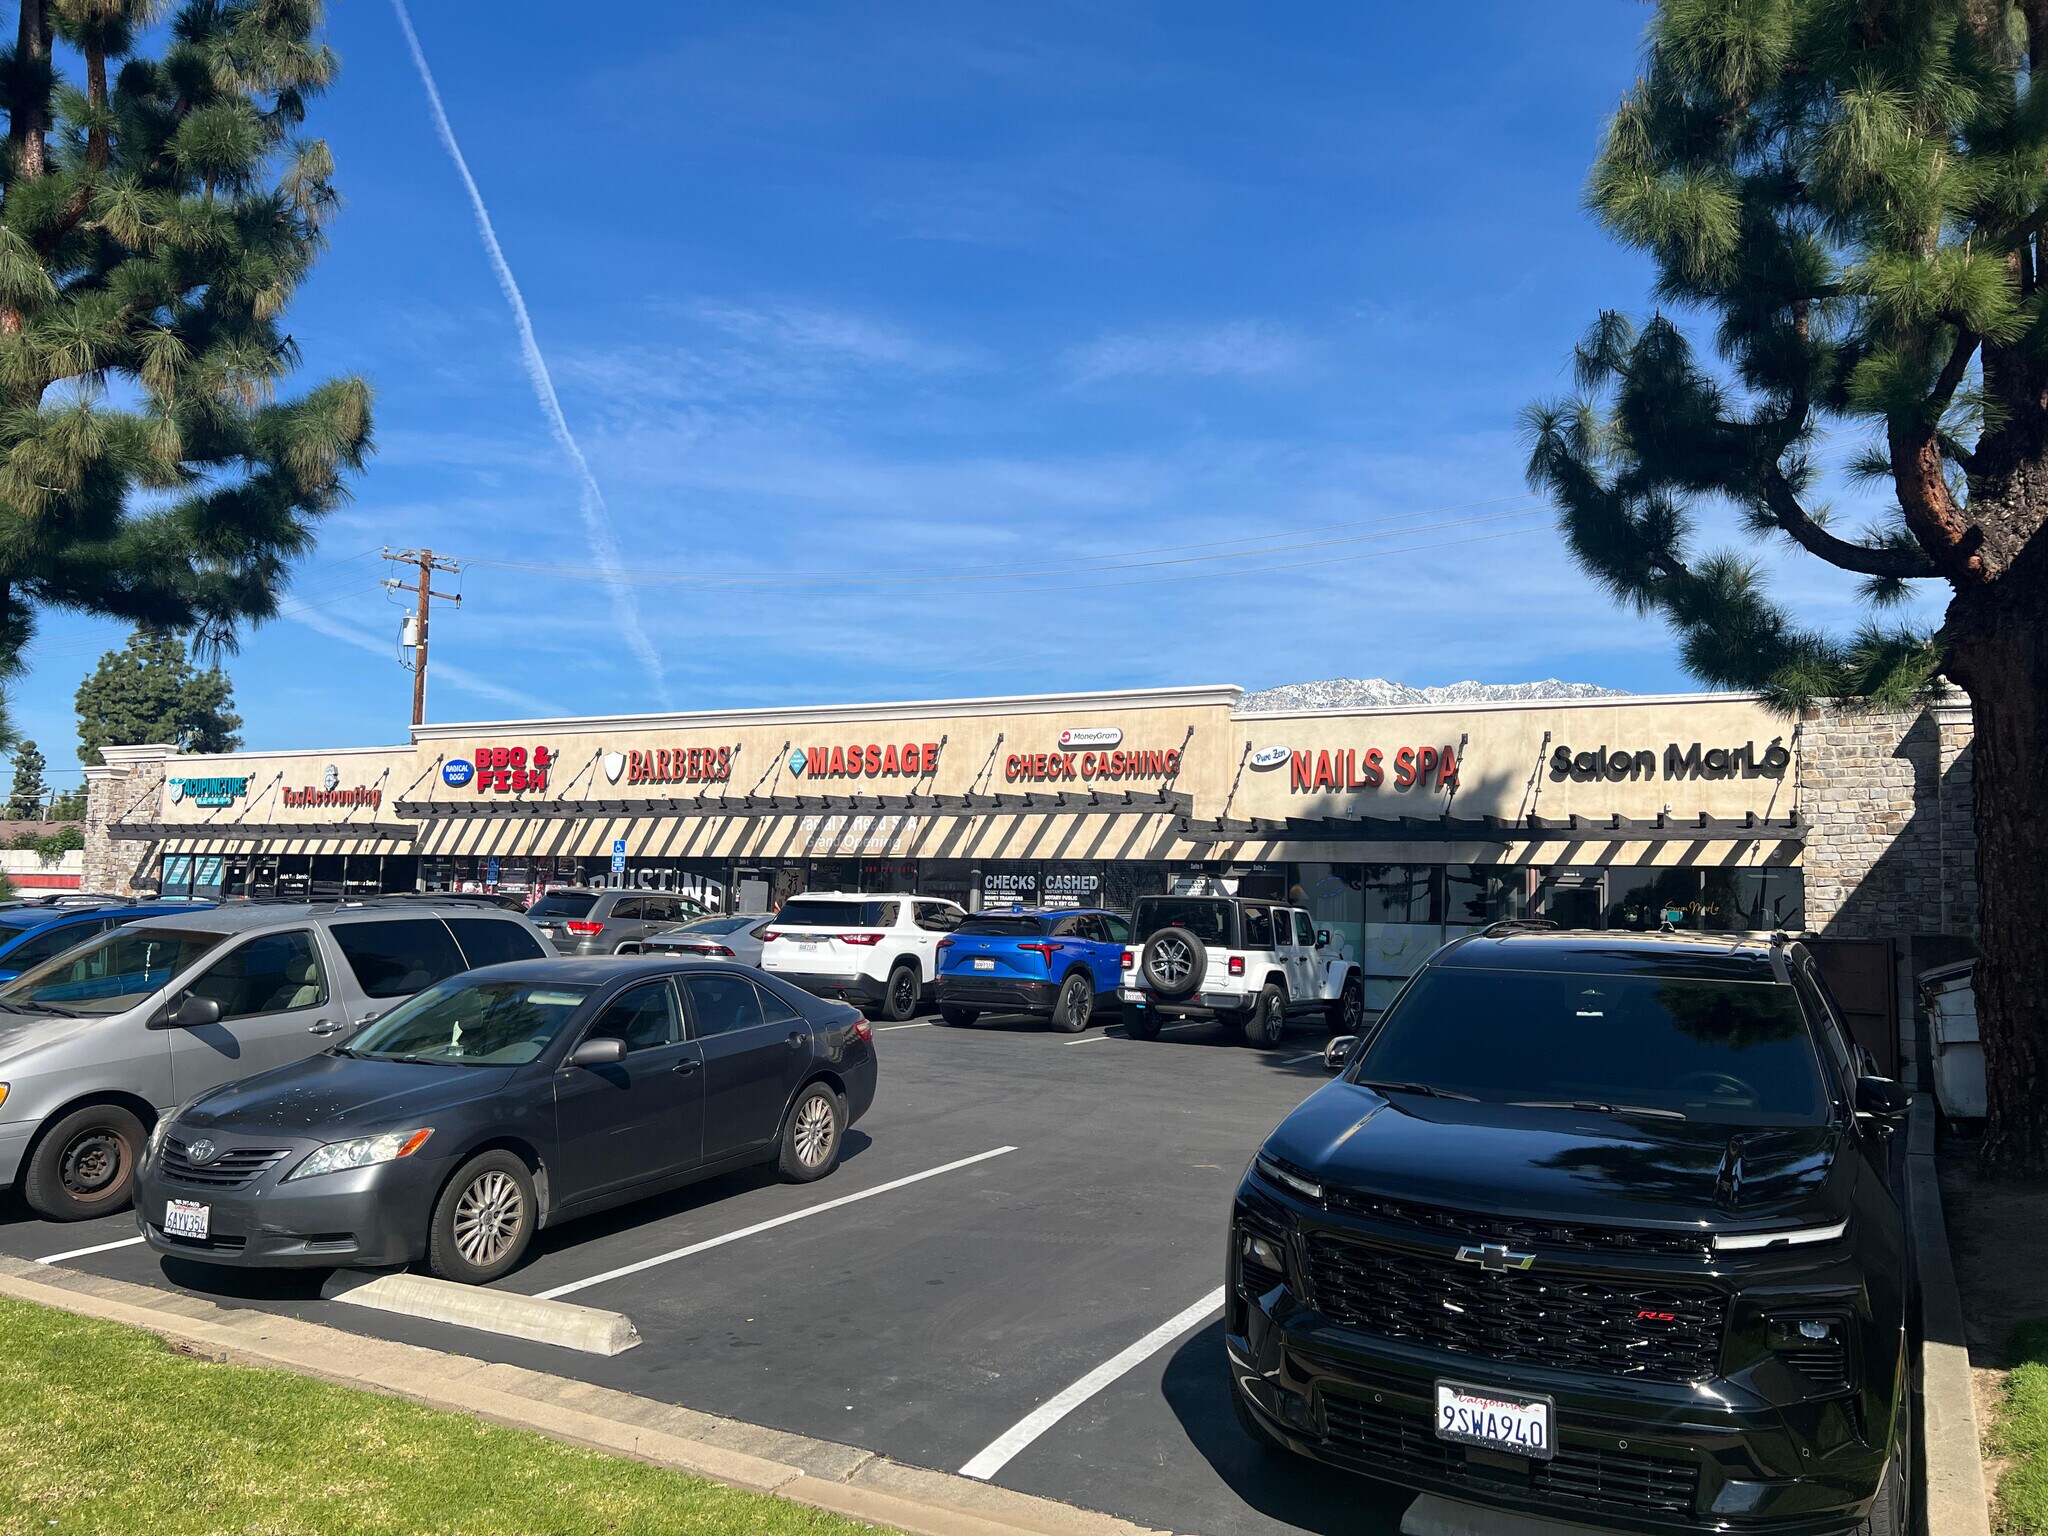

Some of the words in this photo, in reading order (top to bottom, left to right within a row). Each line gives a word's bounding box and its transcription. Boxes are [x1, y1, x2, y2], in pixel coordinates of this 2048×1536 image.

[1073, 732, 1118, 745] MoneyGram
[475, 747, 528, 771] BBQ
[534, 746, 552, 769] &
[628, 747, 730, 783] BARBERS
[808, 743, 937, 776] MASSAGE
[1006, 753, 1077, 778] CHECK
[1082, 750, 1180, 776] CASHING
[1255, 753, 1273, 764] Pure
[1273, 749, 1287, 760] Zen
[1292, 749, 1384, 789] NAILS
[1396, 745, 1460, 788] SPA
[1552, 745, 1656, 775] Salon
[184, 777, 247, 796] ACUPUNCTURE
[478, 770, 548, 793] FISH
[282, 785, 380, 809] Tax/Accounting
[800, 815, 836, 831] Facial
[854, 815, 886, 831] Head
[891, 815, 917, 831] SPA
[807, 836, 841, 848] Grand
[844, 834, 903, 850] Opening
[985, 875, 1036, 890] CHECKS
[1045, 875, 1099, 890] CASHED
[167, 1212, 206, 1233] 6AYV354
[1637, 1311, 1676, 1321] RS
[1458, 1395, 1530, 1413] California
[1443, 1405, 1543, 1448] 9SWA940
